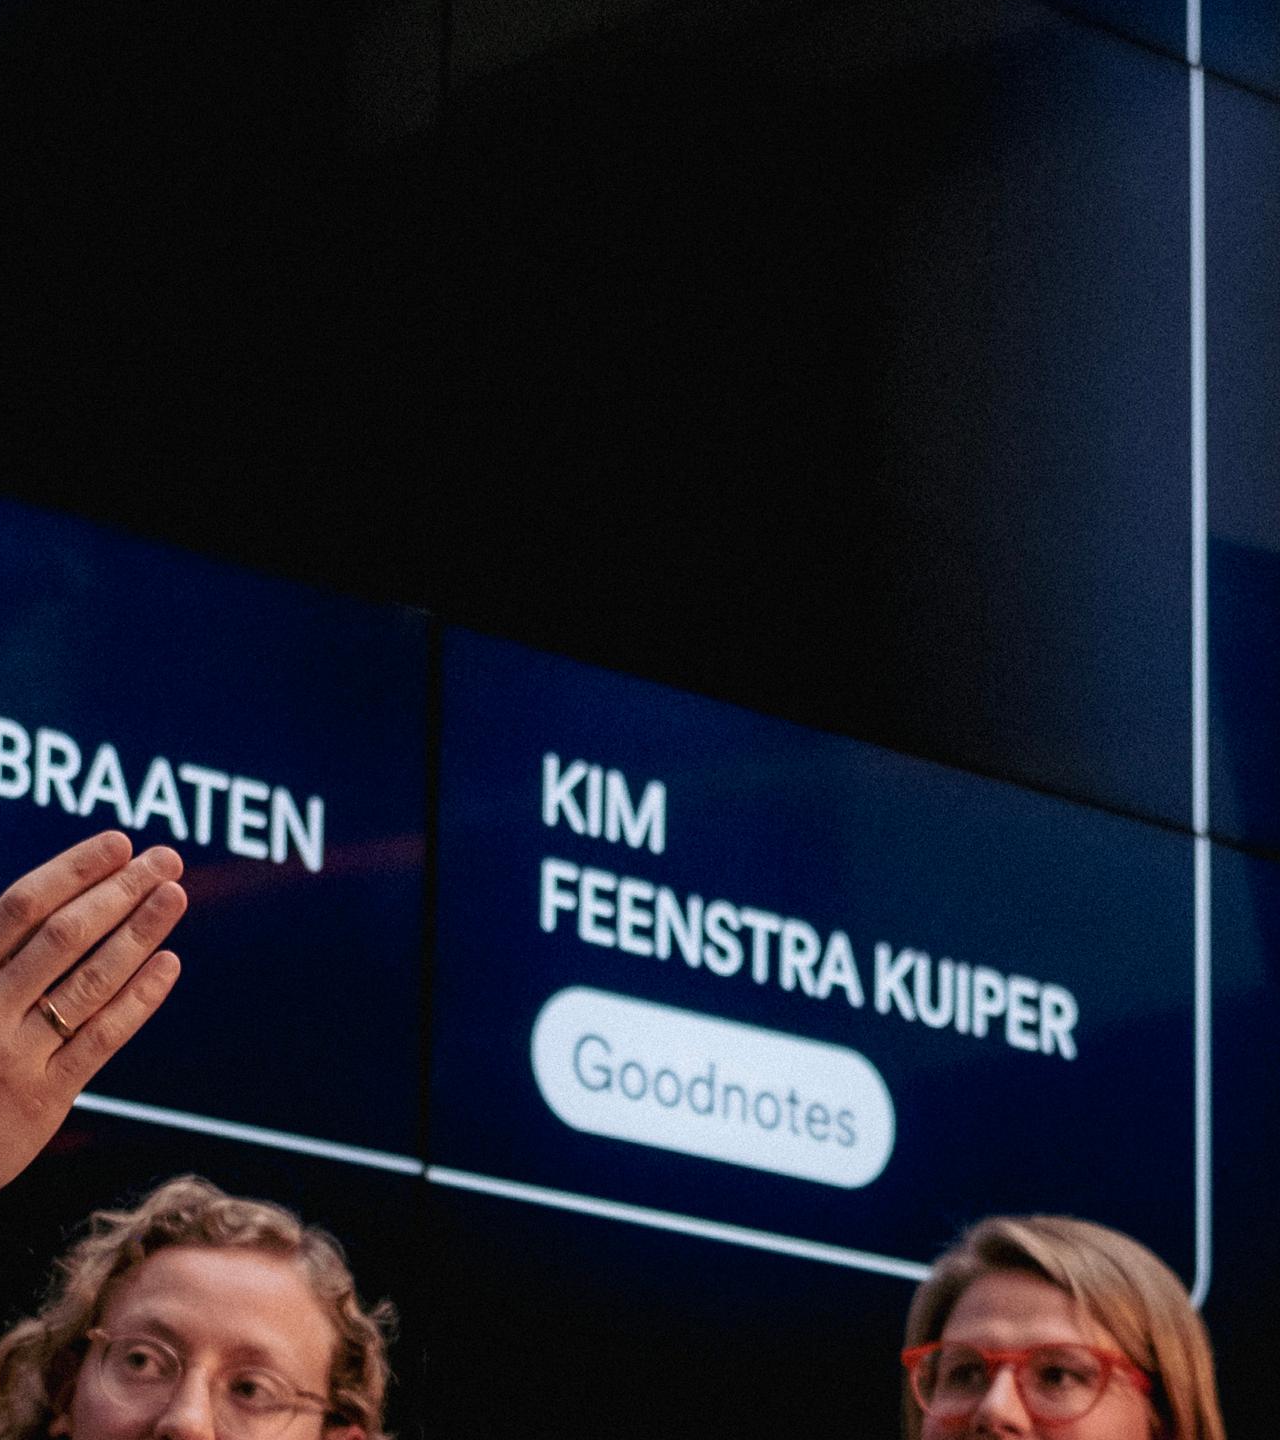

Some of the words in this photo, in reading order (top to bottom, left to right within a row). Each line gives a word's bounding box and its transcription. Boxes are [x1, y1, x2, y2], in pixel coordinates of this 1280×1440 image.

[542, 753, 667, 855] KIM
[540, 858, 864, 1009] FEENSTRA
[874, 943, 1079, 1060] KUIPER
[572, 1032, 859, 1148] Goodnotes
